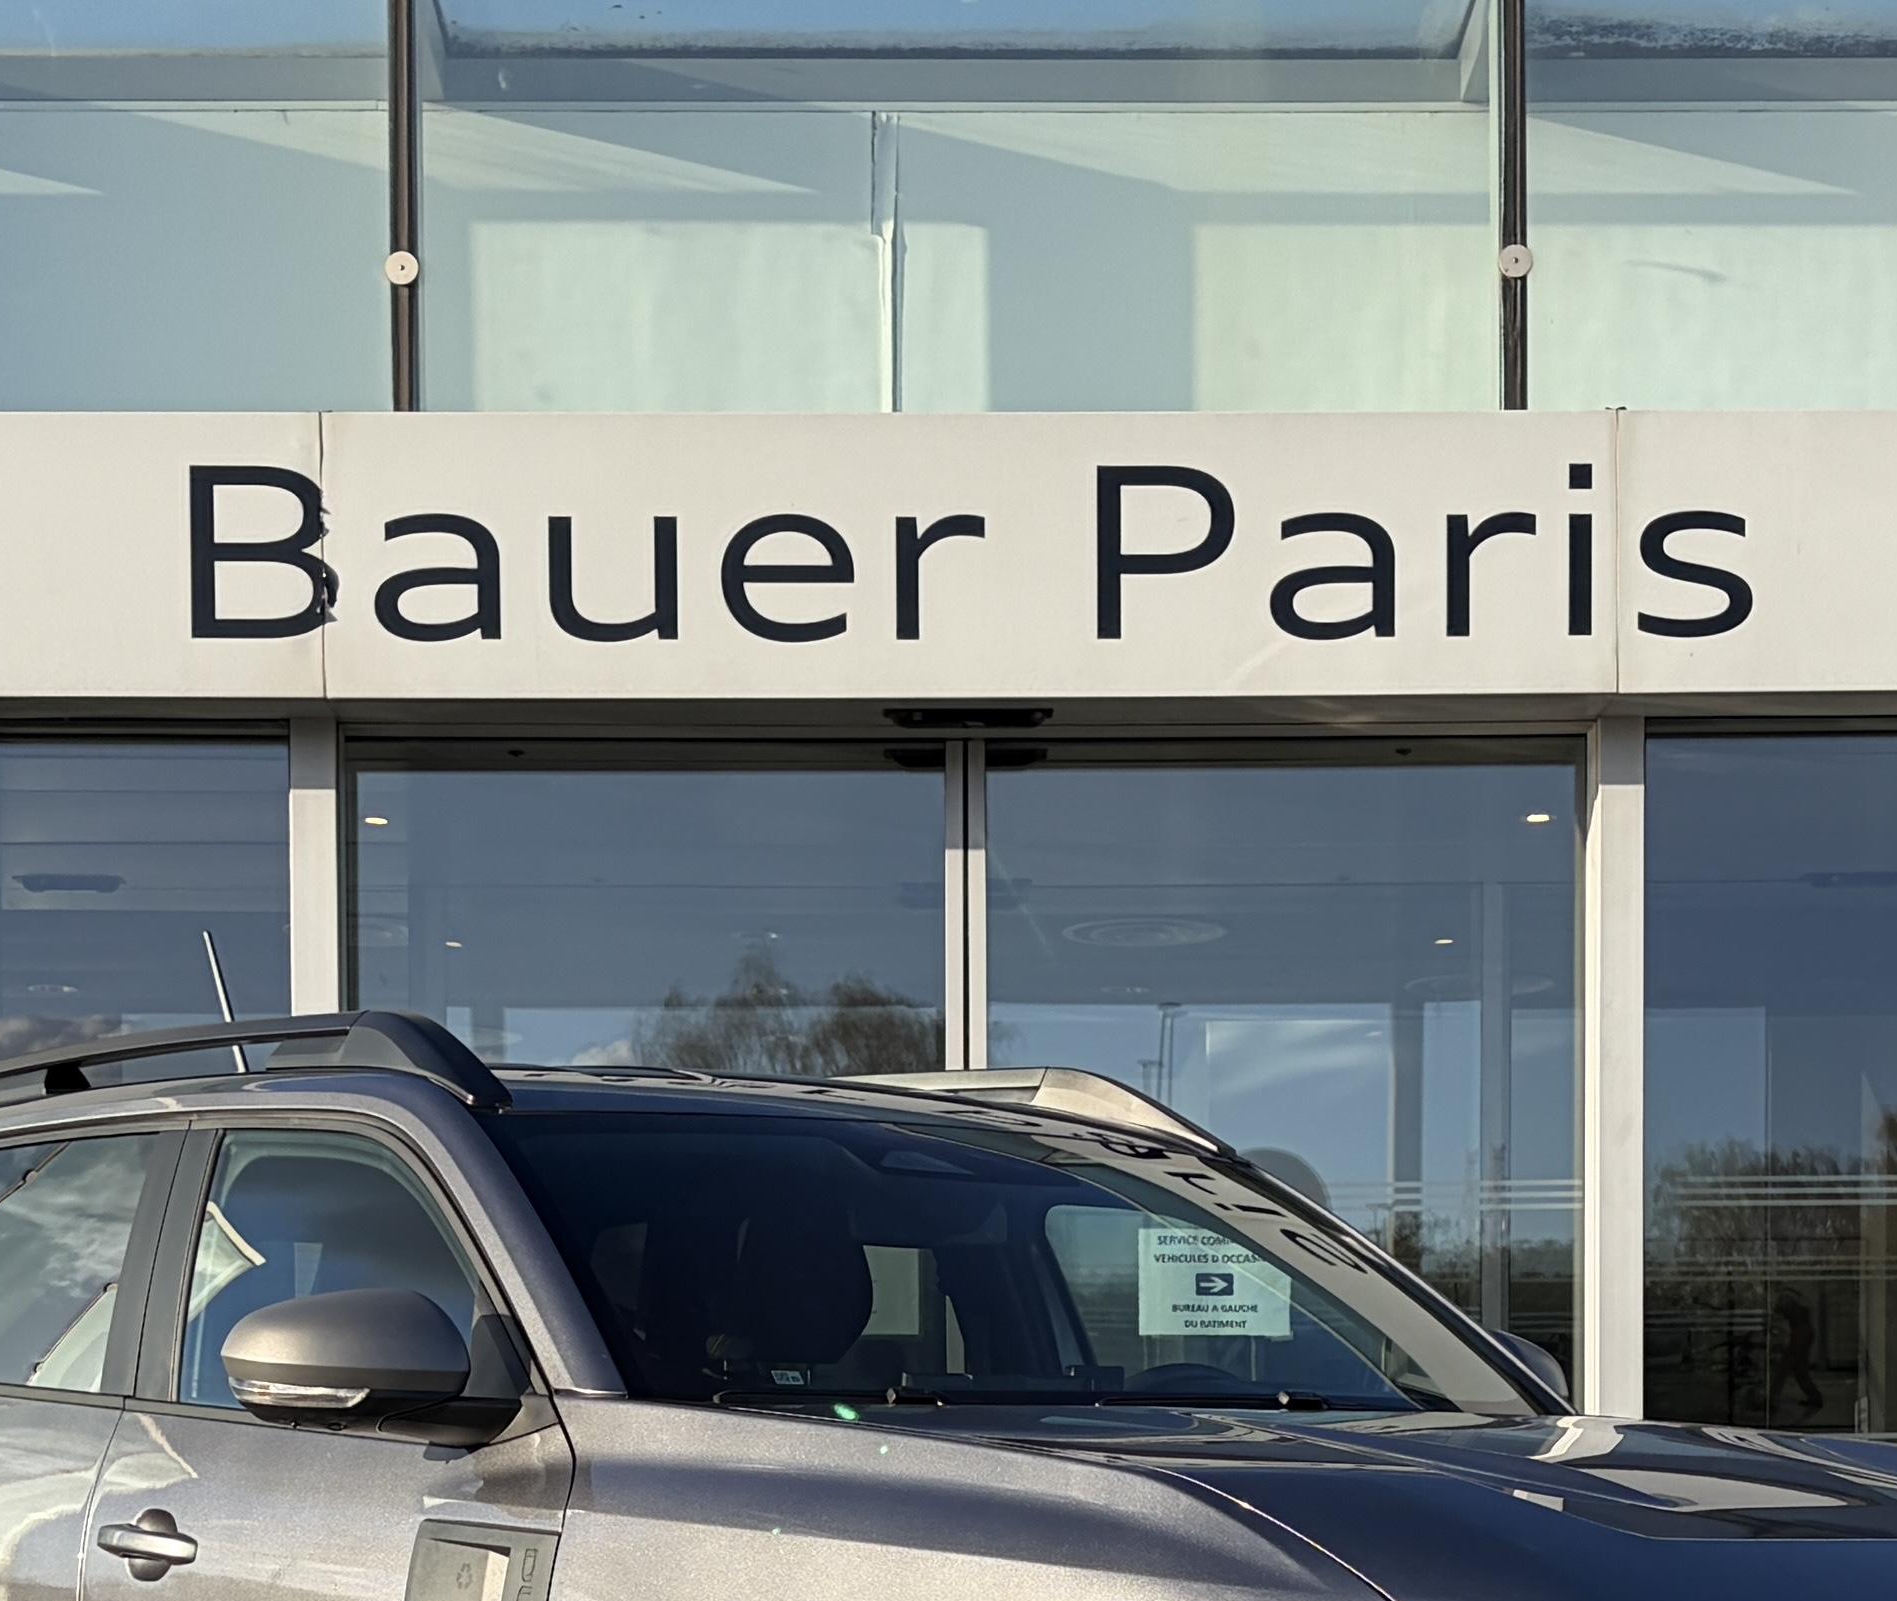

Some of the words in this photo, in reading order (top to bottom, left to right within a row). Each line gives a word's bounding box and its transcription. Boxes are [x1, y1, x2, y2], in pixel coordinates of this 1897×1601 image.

[189, 464, 985, 643] Bauer
[1096, 463, 1753, 641] Paris
[1157, 1235, 1198, 1246] SERVICE
[1171, 1303, 1210, 1313] BUREAU
[1184, 1319, 1198, 1329] DU
